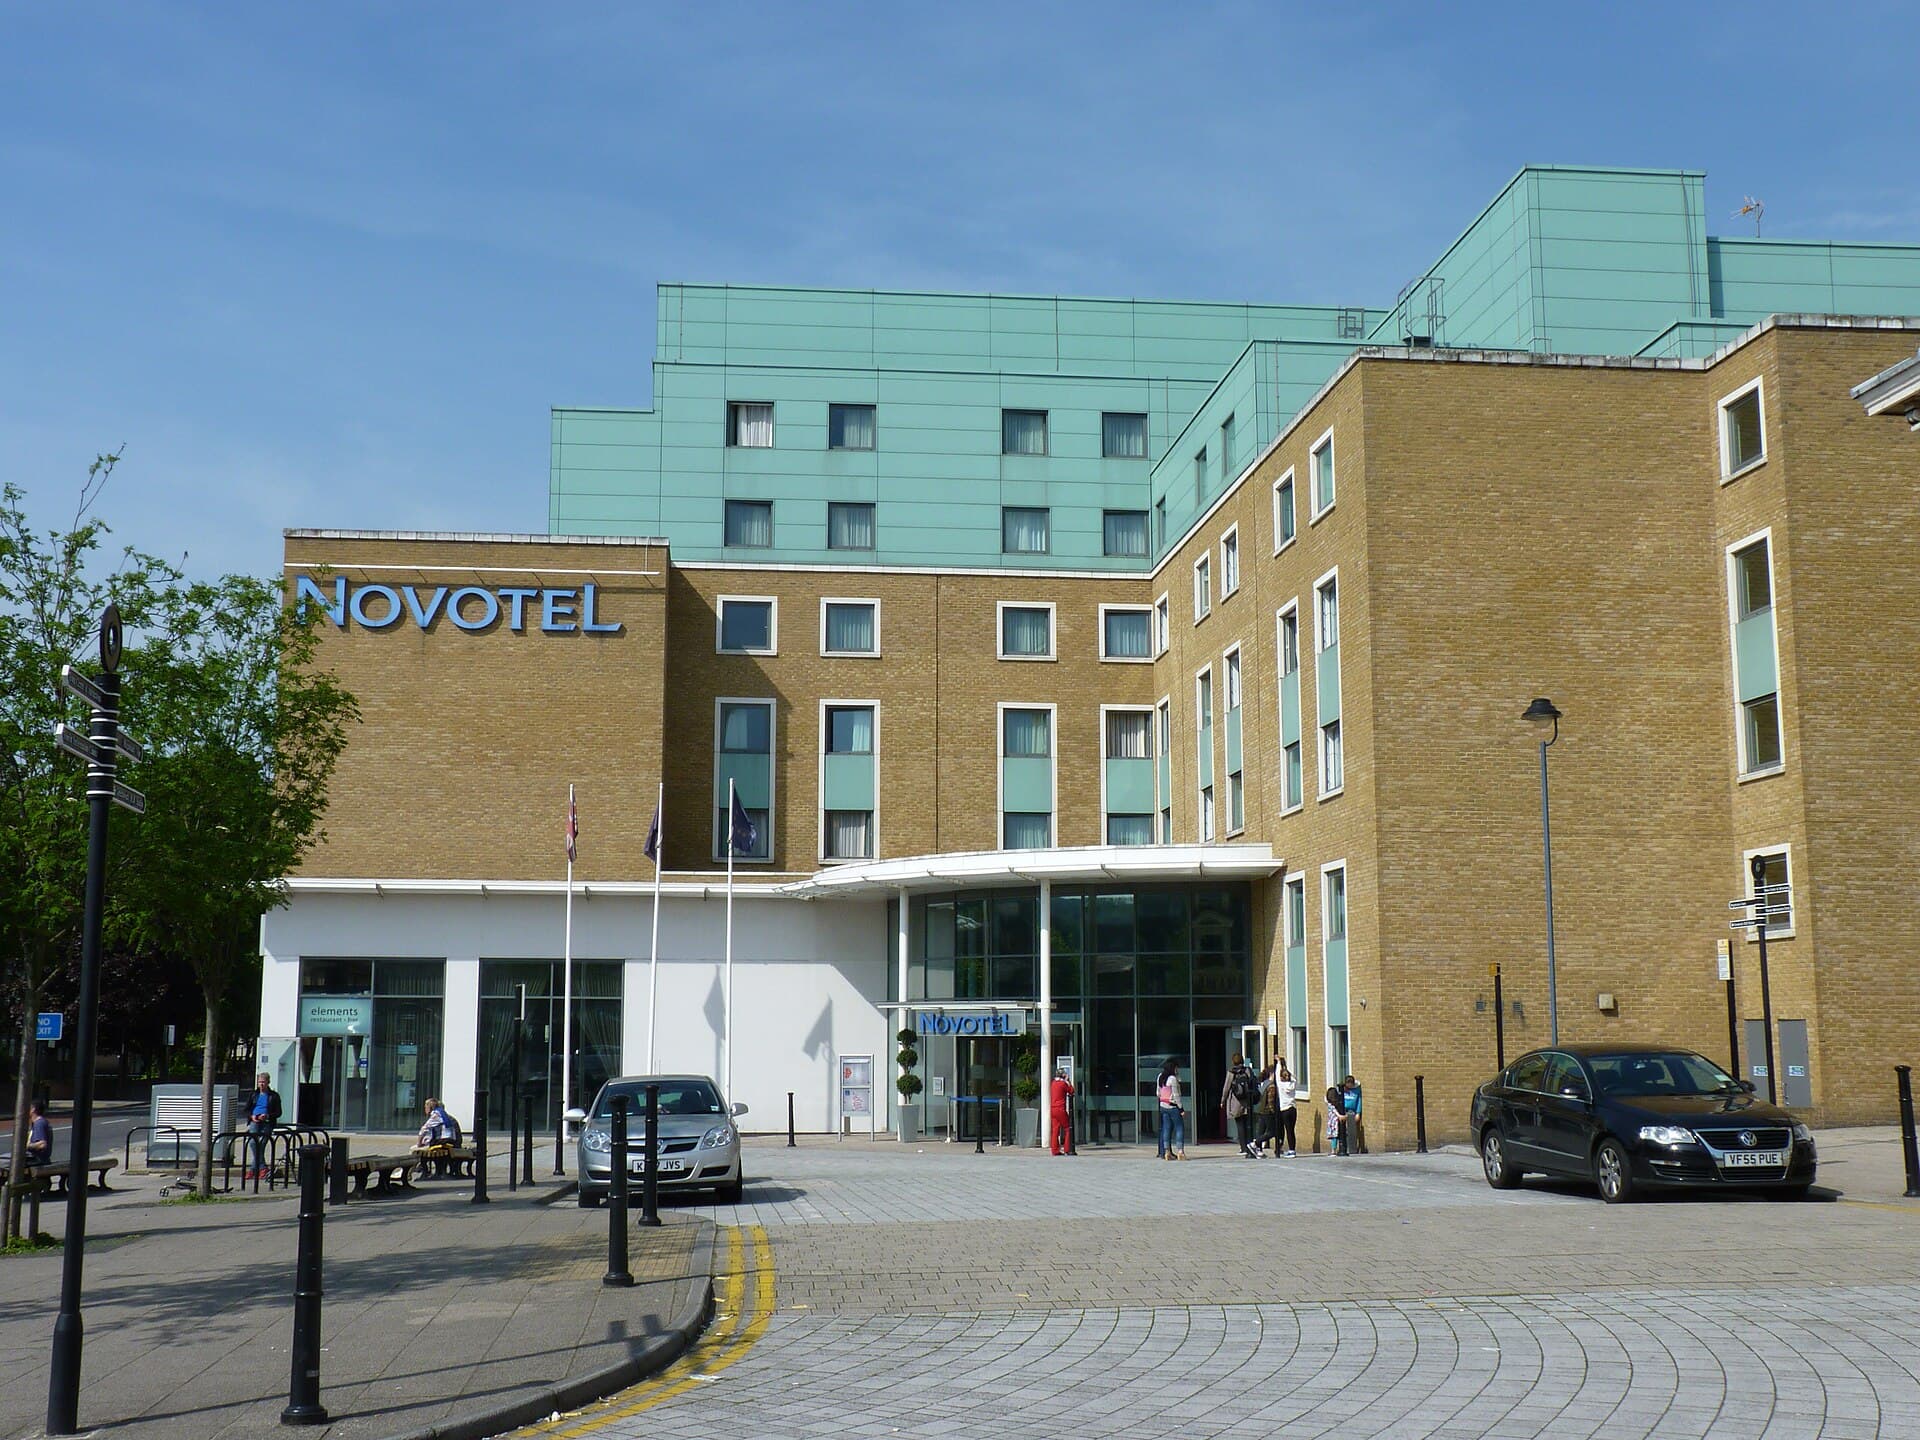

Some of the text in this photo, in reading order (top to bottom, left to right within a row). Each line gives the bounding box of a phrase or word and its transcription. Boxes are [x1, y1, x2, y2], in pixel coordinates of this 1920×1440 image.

[295, 575, 622, 633] NOVOTEL
[311, 1006, 358, 1015] elements
[919, 1012, 1017, 1035] NOVOTEL
[1729, 1153, 1778, 1165] VF55 PUE
